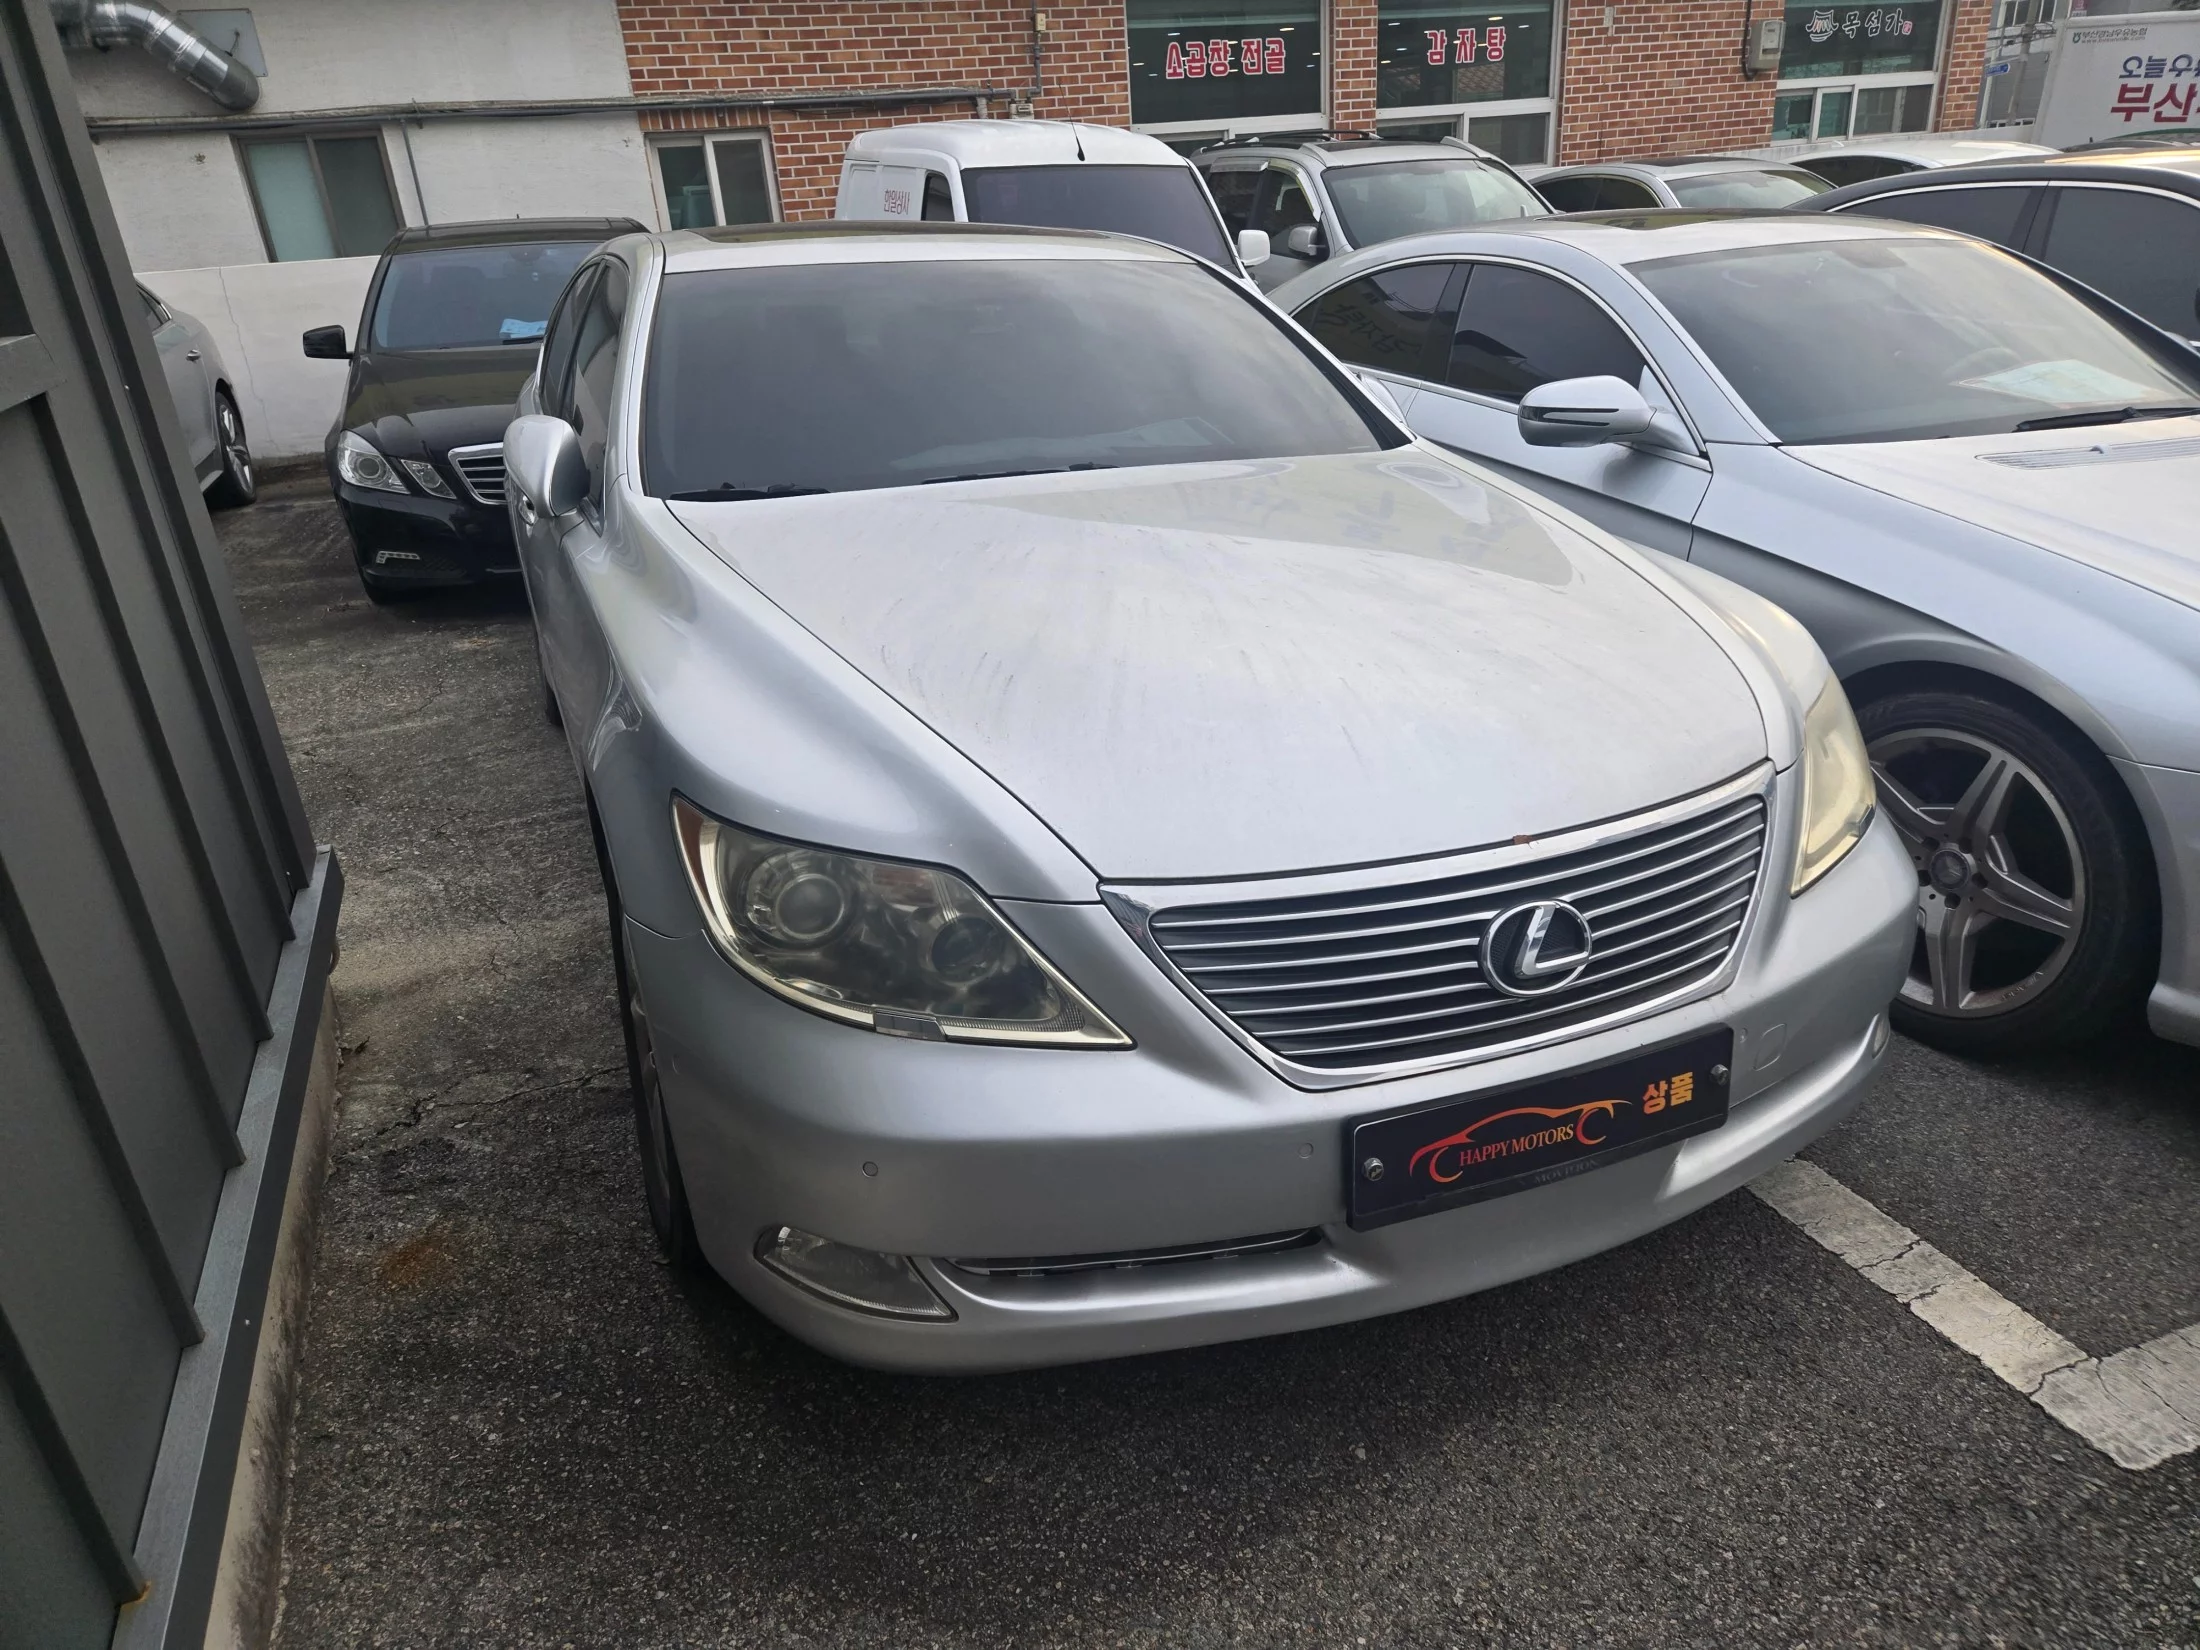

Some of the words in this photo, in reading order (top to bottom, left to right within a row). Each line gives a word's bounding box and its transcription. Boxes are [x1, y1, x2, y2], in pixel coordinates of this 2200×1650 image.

[1842, 8, 1904, 39] 목섬가
[1166, 39, 1231, 79] 소곱창
[1241, 38, 1286, 75] 전골
[1427, 26, 1506, 65] 감자탕
[2119, 54, 2200, 78] 오늘우
[2110, 83, 2200, 123] 부산
[884, 189, 910, 215] 한일상사
[1643, 1071, 1693, 1115] 상품
[1459, 1139, 1511, 1167] HAPPY
[1511, 1123, 1574, 1154] MOTORS
